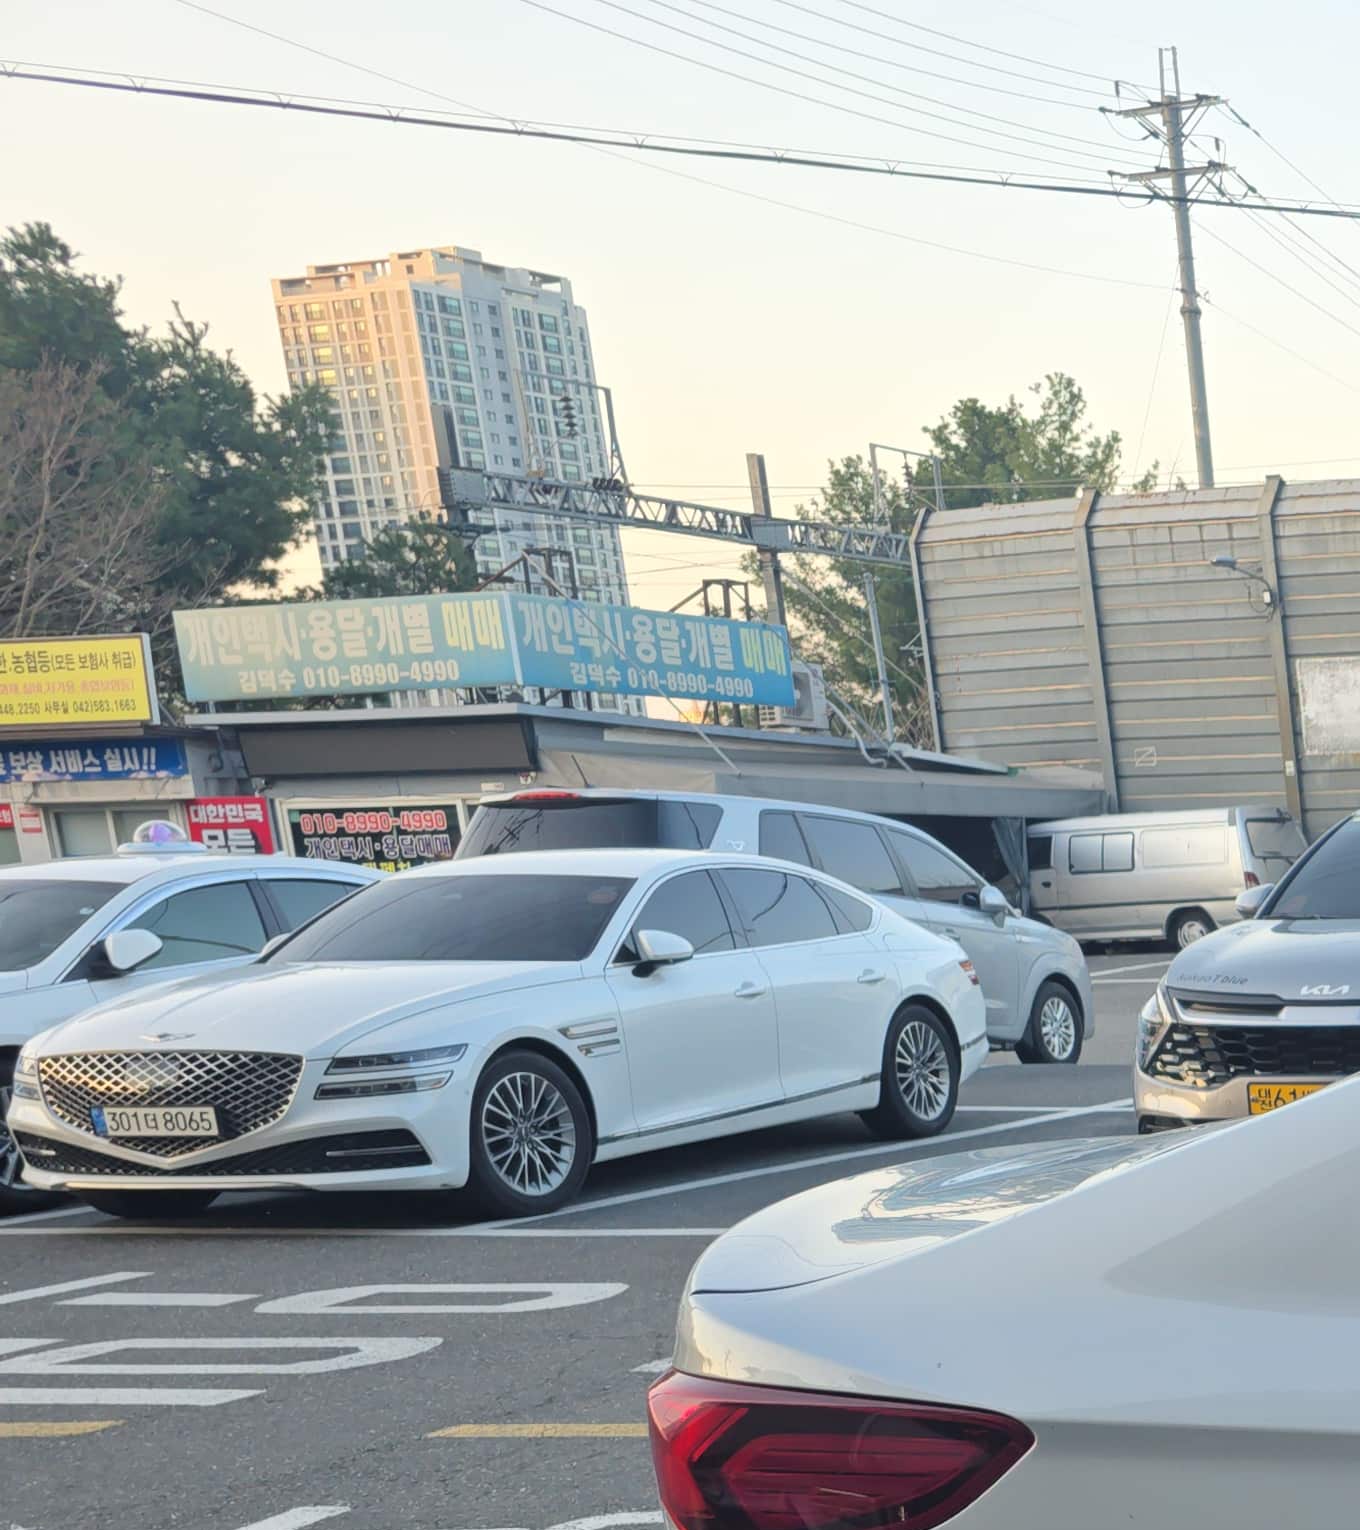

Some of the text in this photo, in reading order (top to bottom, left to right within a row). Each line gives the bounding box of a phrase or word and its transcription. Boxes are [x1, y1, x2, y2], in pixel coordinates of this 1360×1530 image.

[441, 599, 505, 652] 매매
[78, 652, 110, 671] 보험사
[111, 650, 137, 670] 취급)
[739, 626, 788, 677] 매매
[237, 659, 460, 694] 김덕수 010-8990-4990
[569, 661, 754, 698] 김덕수 010-8990-4990
[9, 750, 43, 775] 보상
[50, 748, 102, 773] 서비스
[103, 746, 157, 772] 실시!!
[189, 803, 264, 824] 대한민국
[299, 809, 448, 836] 010-8990-4990
[202, 828, 256, 854] 모든
[107, 1111, 213, 1132] 301더 8065
